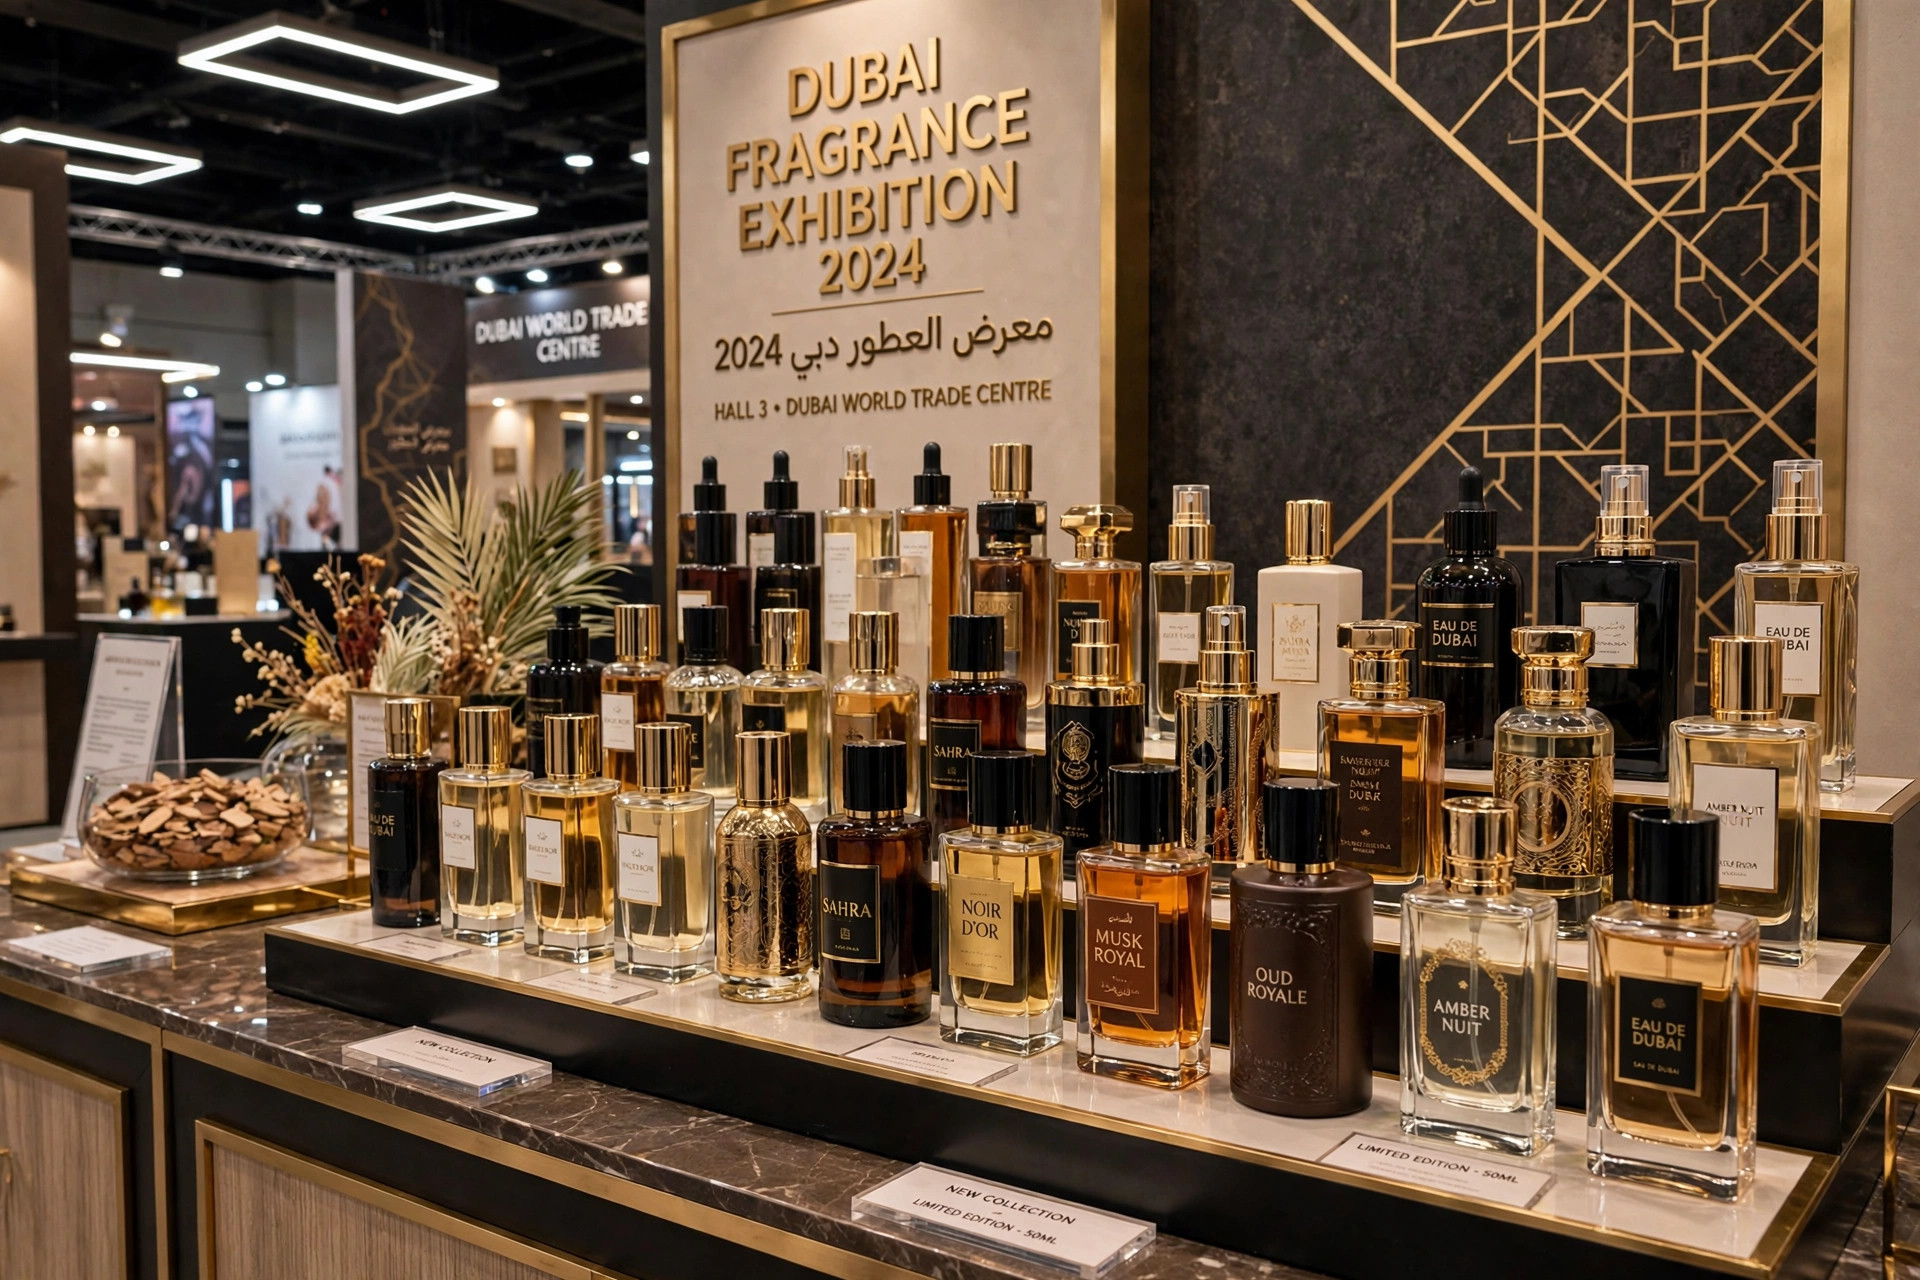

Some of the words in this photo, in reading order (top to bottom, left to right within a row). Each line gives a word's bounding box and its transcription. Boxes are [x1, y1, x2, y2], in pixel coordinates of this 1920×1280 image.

[788, 36, 941, 118] DUBAI
[725, 87, 1030, 192] FRAGRANCE
[738, 159, 1018, 252] EXHIBITION
[818, 236, 926, 295] 2024
[474, 315, 524, 345] DUBAI
[524, 308, 588, 338] WORLD
[589, 300, 649, 332] TRADE
[846, 315, 942, 367] العطور
[953, 313, 1054, 358] معرض
[535, 333, 602, 363] CENTRE
[714, 333, 783, 372] 2024
[790, 336, 839, 381] دبي
[714, 401, 755, 421] HALL
[758, 399, 769, 419] 3
[786, 394, 838, 417] DUBAI
[842, 389, 907, 413] WORLD
[911, 384, 972, 409] TRADE
[976, 378, 1053, 405] CENTRE
[1433, 620, 1457, 631] EAU
[1460, 620, 1478, 632] DE
[1766, 626, 1790, 638] EAU
[1794, 627, 1811, 638] DE
[1432, 633, 1478, 647] DUBAI
[1781, 639, 1809, 651] BAI
[933, 744, 972, 759] SAHRA
[1705, 802, 1737, 813] AMBER
[369, 824, 394, 837] UBAI
[381, 814, 396, 826] DE
[822, 897, 872, 918] SAHRA
[961, 898, 1002, 919] NOIR
[1095, 928, 1144, 950] MUSK
[1094, 946, 1146, 969] ROYAL
[1255, 966, 1293, 986] OUD
[1247, 981, 1308, 1005] ROYALE
[1433, 998, 1491, 1021] AMBER
[1442, 1016, 1483, 1037] NUIT
[1631, 1016, 1661, 1033] EAU
[1666, 1021, 1686, 1037] DE
[1632, 1030, 1682, 1052] DUBAI
[1356, 1143, 1410, 1160] LIMITED
[1413, 1155, 1471, 1173] EDITION
[1482, 1169, 1519, 1184] 50ML
[945, 1184, 982, 1199] NEW
[983, 1194, 1077, 1226] COLLECTION
[912, 1197, 962, 1217] LIMITED
[962, 1211, 1015, 1232] EDITION
[1023, 1229, 1058, 1245] 50ML
